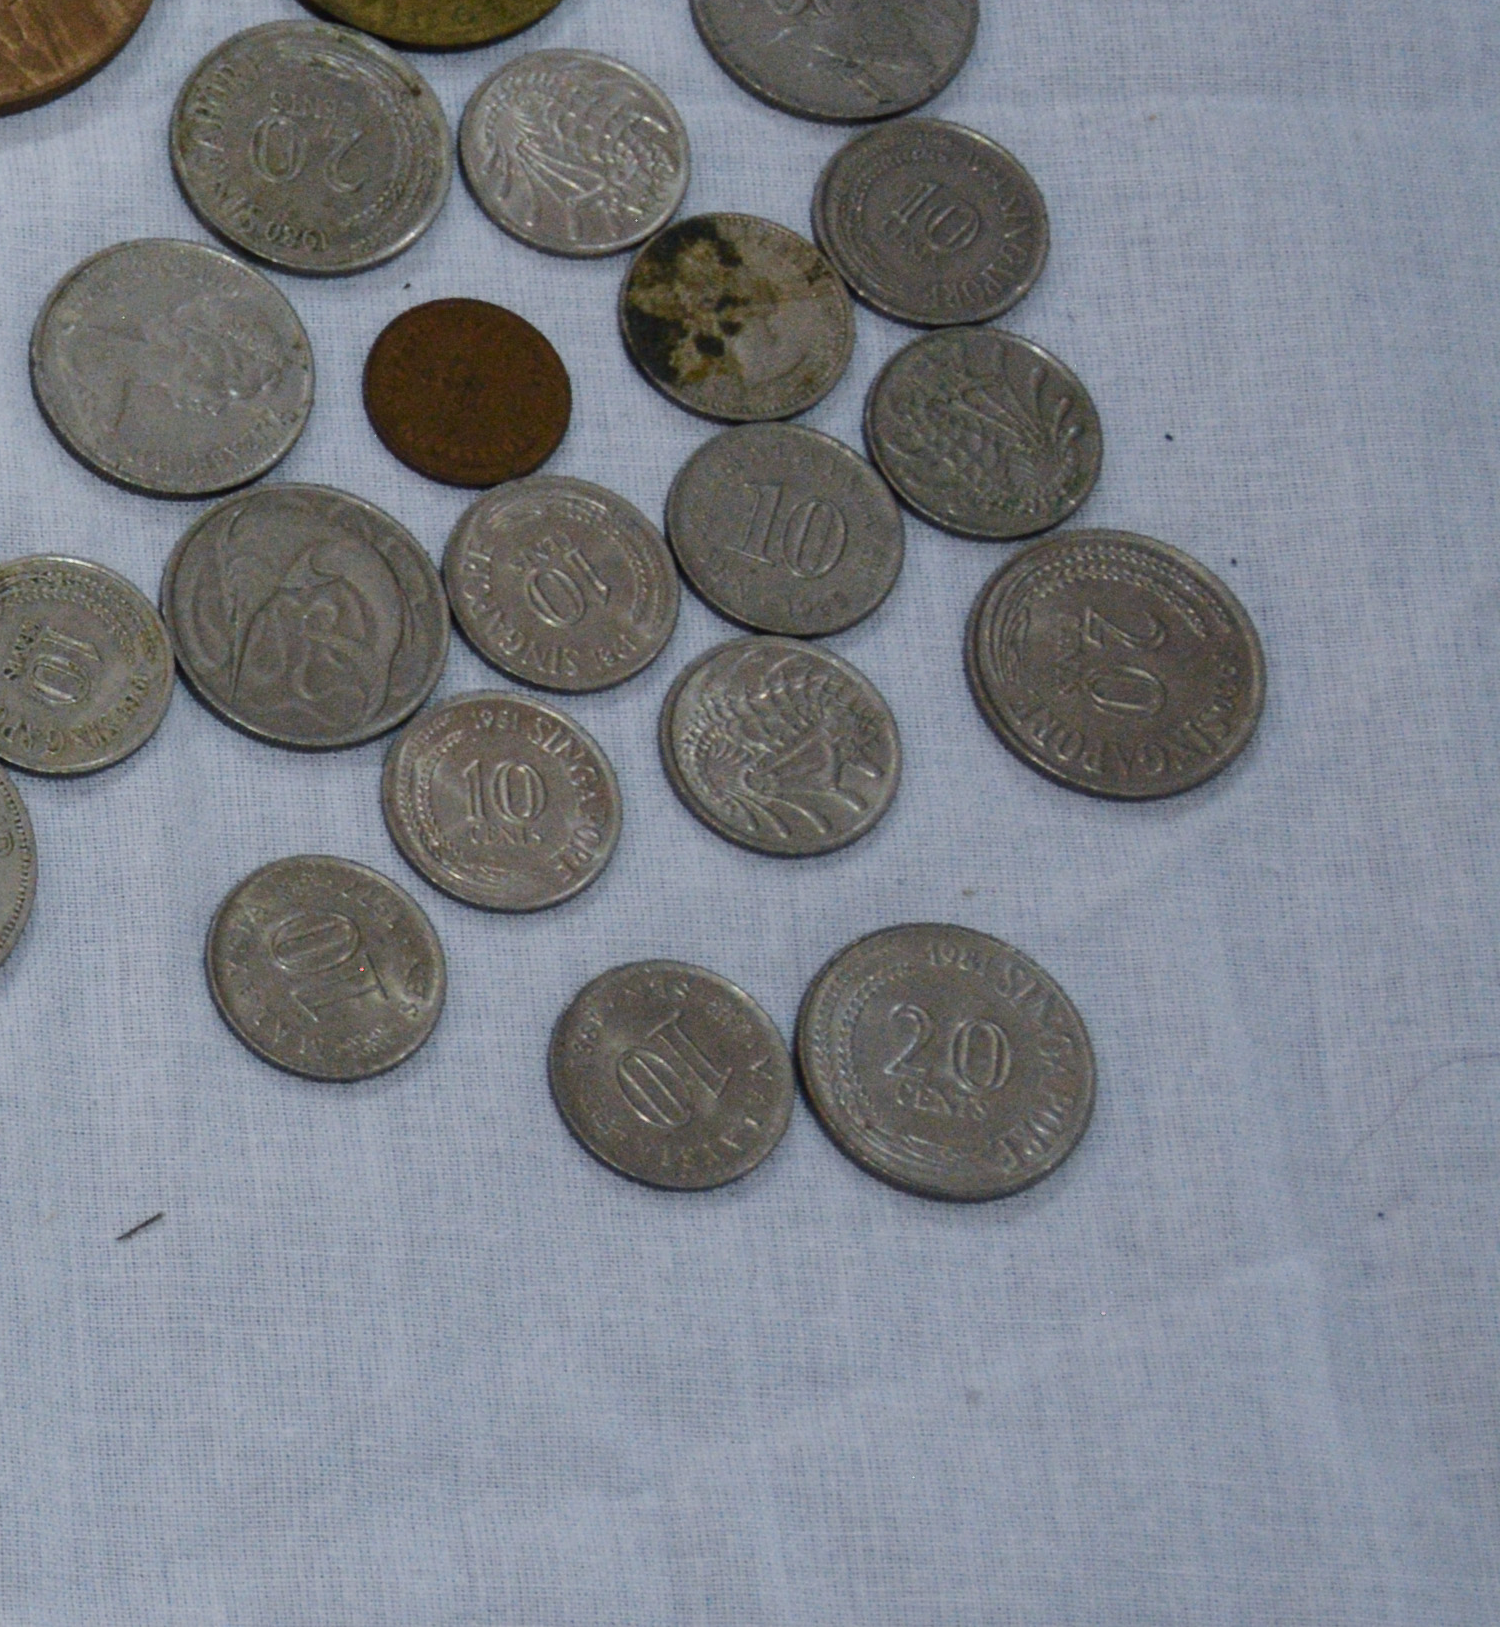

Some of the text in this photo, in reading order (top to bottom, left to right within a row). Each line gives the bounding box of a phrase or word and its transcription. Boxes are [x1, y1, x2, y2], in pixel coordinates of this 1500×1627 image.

[256, 115, 367, 195] 20
[888, 176, 982, 256] 10
[723, 480, 848, 580] 10
[529, 545, 611, 627] 10
[1084, 607, 1162, 714] 20
[462, 758, 549, 826] 10
[616, 1010, 734, 1126] 10
[883, 1002, 1012, 1094] 20
